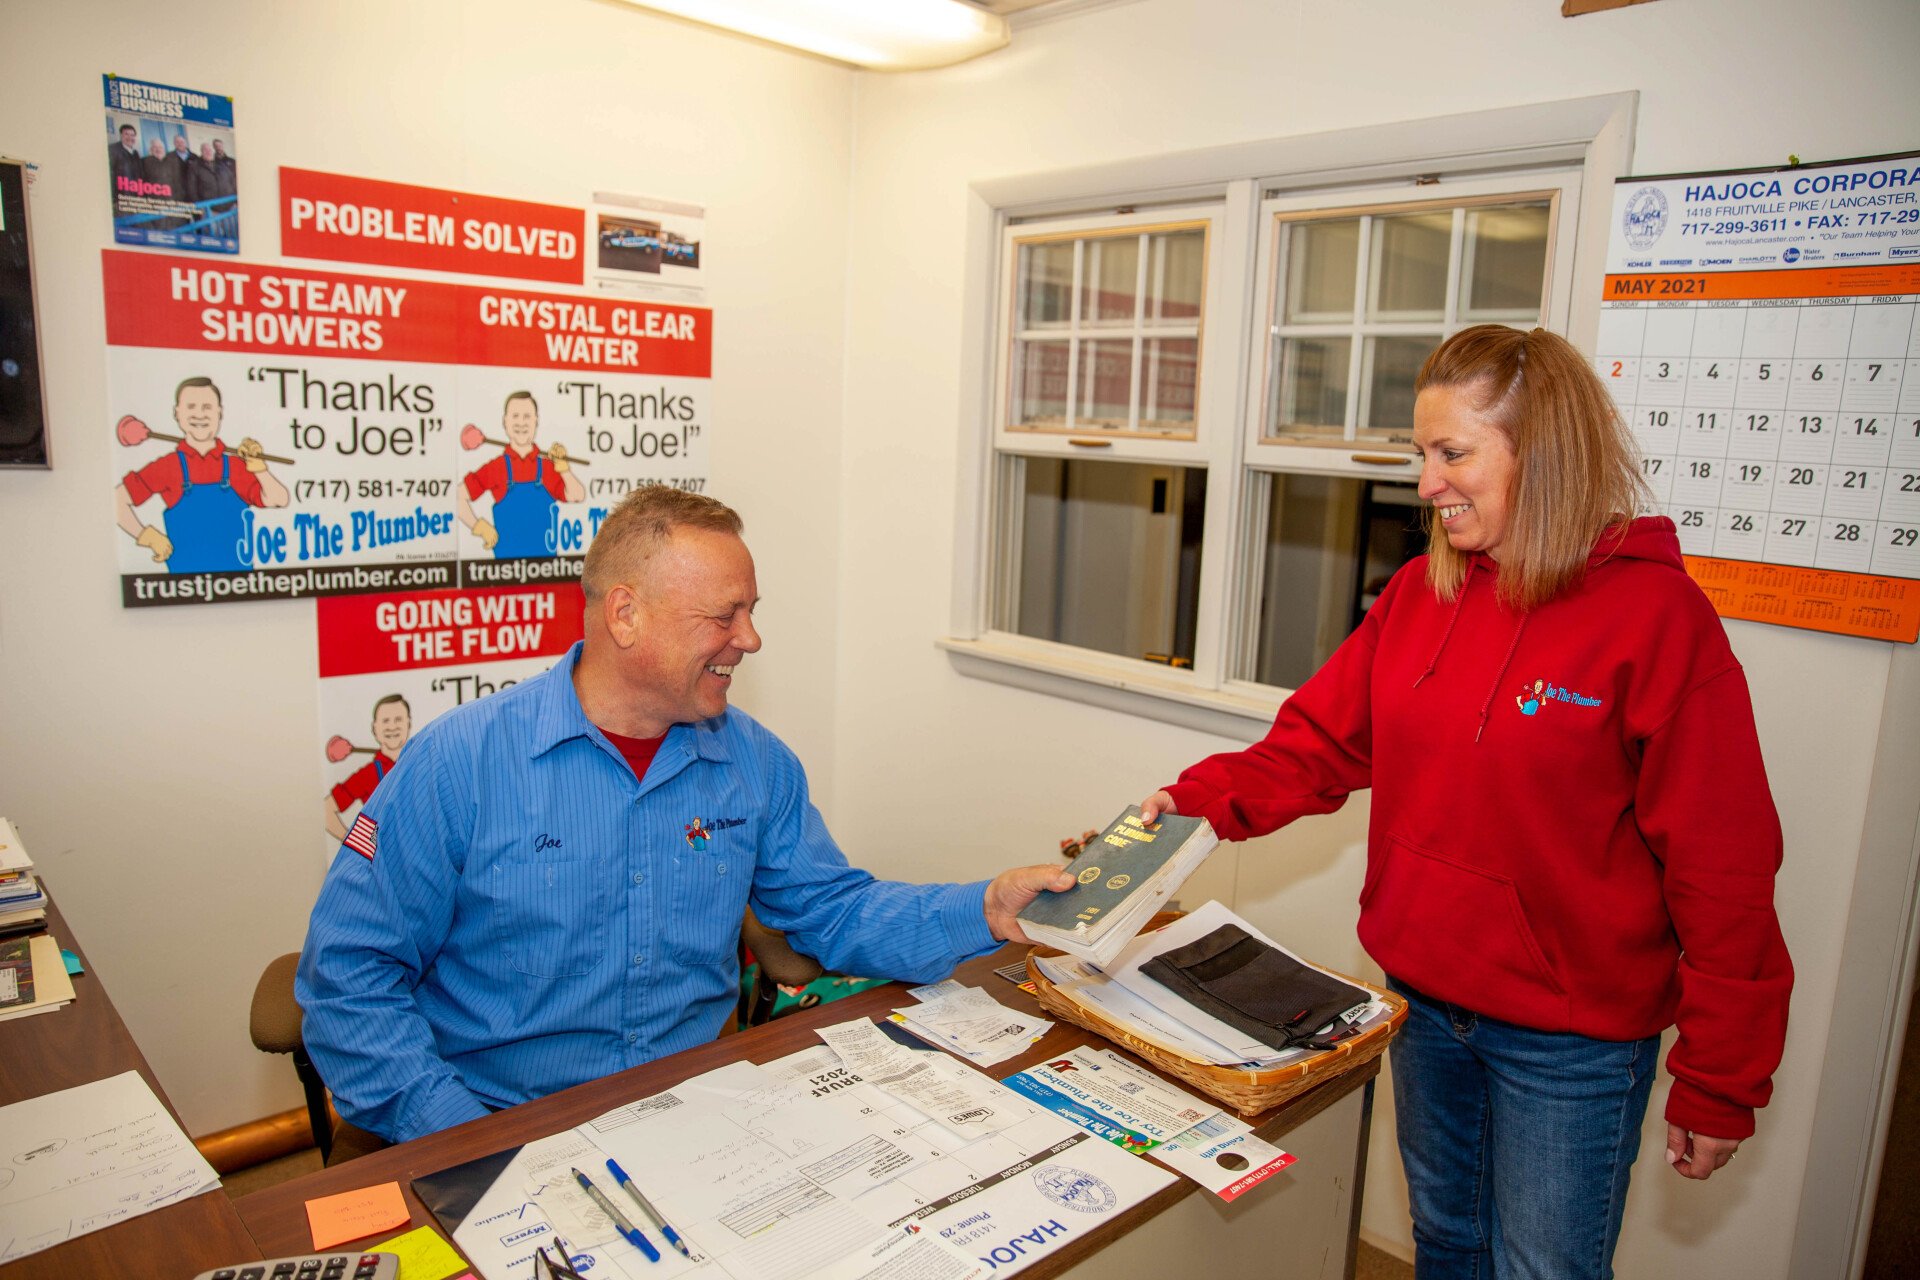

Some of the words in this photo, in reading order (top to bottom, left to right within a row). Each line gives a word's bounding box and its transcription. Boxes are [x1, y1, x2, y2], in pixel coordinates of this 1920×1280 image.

[119, 80, 208, 110] DISTRIBUTION
[120, 94, 184, 118] BUSINESS
[117, 176, 172, 196] Hajoca
[1685, 180, 1783, 202] HAJOCA
[1793, 166, 1920, 196] CORPORA
[1686, 207, 1712, 217] 1418
[1715, 202, 1786, 217] FRUITVILLE
[1789, 199, 1819, 212] PIKE
[1830, 192, 1918, 209] LANCASTER,
[290, 197, 455, 247] PROBLEM
[463, 219, 577, 260] SOLVED
[1681, 218, 1787, 236] 717-299-3611
[1807, 214, 1850, 230] FAX:
[1857, 208, 1920, 226] 717-29
[1705, 234, 1806, 246] www.HajocaLancaster.com
[1841, 231, 1863, 240] Team
[1865, 229, 1898, 240] Helping
[1627, 260, 1652, 268] KOHLER
[171, 267, 249, 305] HOT
[260, 275, 407, 318] STEAMY
[1614, 279, 1656, 294] MAY
[1660, 279, 1708, 294] 2021
[1610, 301, 1639, 309] SUNDAY
[1707, 300, 1741, 308] TUESDAY
[1751, 299, 1800, 307] WEDNESDAY
[1809, 297, 1850, 305] THURSDAY
[1872, 296, 1903, 304] FRIDAY
[479, 295, 605, 334] CRYSTAL
[611, 307, 696, 341] CLEAR
[201, 308, 384, 350] SHOWERS
[545, 333, 639, 367] WATER
[1611, 361, 1623, 378] 2
[1658, 362, 1670, 378] 3
[1707, 363, 1719, 380] 4
[1758, 364, 1771, 381] 5
[1811, 364, 1824, 381] 6
[1868, 364, 1882, 382] 7
[247, 366, 435, 414] “Thanks
[557, 381, 695, 421] “Thanks
[1648, 410, 1668, 427] 10
[1696, 412, 1717, 430] 11
[1747, 414, 1770, 432] 12
[1798, 416, 1822, 434] 13
[1853, 418, 1878, 436] 14
[290, 418, 326, 450] to
[336, 416, 443, 456] Joe!”
[587, 426, 614, 453] to
[621, 423, 701, 458] Joe!”
[1641, 459, 1662, 475] 17
[1689, 461, 1711, 478] 18
[1739, 464, 1762, 482] 19
[1789, 468, 1814, 486] 20
[1842, 470, 1868, 489] 21
[294, 480, 350, 502] (717)
[358, 479, 452, 499] 581-7407
[589, 478, 631, 498] (717)
[236, 507, 287, 566] Joe
[294, 512, 344, 560] The
[350, 505, 454, 552] Plumber
[545, 501, 583, 553] Joe
[1681, 510, 1704, 527] 25
[1730, 514, 1753, 532] 26
[1781, 518, 1807, 537] 27
[1834, 523, 1861, 542] 28
[1890, 528, 1919, 547] 29
[468, 558, 584, 583] trustjoethe
[133, 565, 449, 602] trustjoetheplumber.com
[375, 597, 473, 632] GOING
[477, 592, 555, 624] WITH
[391, 631, 454, 663] THE
[462, 623, 543, 656] FLOW
[1545, 682, 1557, 698] Joe
[1557, 687, 1571, 702] The
[1571, 692, 1602, 707] Plumber
[534, 833, 563, 853] Joe
[1103, 834, 1133, 848] CODE
[1113, 824, 1157, 843] PLUMBING
[808, 1067, 848, 1086] 2021
[1032, 1067, 1091, 1102] Plumber!
[860, 1106, 873, 1115] 23
[1091, 1097, 1113, 1113] the
[1057, 1107, 1092, 1127] Plumber
[1090, 1119, 1109, 1135] The
[1114, 1109, 1139, 1126] Joe
[892, 1127, 906, 1137] 16
[1109, 1127, 1124, 1141] Joe
[1139, 1122, 1165, 1138] Try
[930, 1149, 939, 1158] 9
[1018, 1149, 1027, 1158] 1
[1050, 1137, 1078, 1154] SUNDAY
[1199, 1146, 1218, 1160] with
[999, 1160, 1033, 1179] MONDAY
[1251, 1167, 1270, 1182] (717)
[1267, 1159, 1286, 1172] CALL:
[967, 1172, 977, 1181] 2
[947, 1184, 984, 1203] TUESDAY
[1059, 1178, 1094, 1202] HAJOCA
[914, 1198, 924, 1206] 3
[954, 1210, 992, 1230] Phone:
[506, 1225, 547, 1244] Myers
[970, 1222, 997, 1241] 1418
[303, 1260, 318, 1268] 00
[333, 1257, 341, 1265] 0
